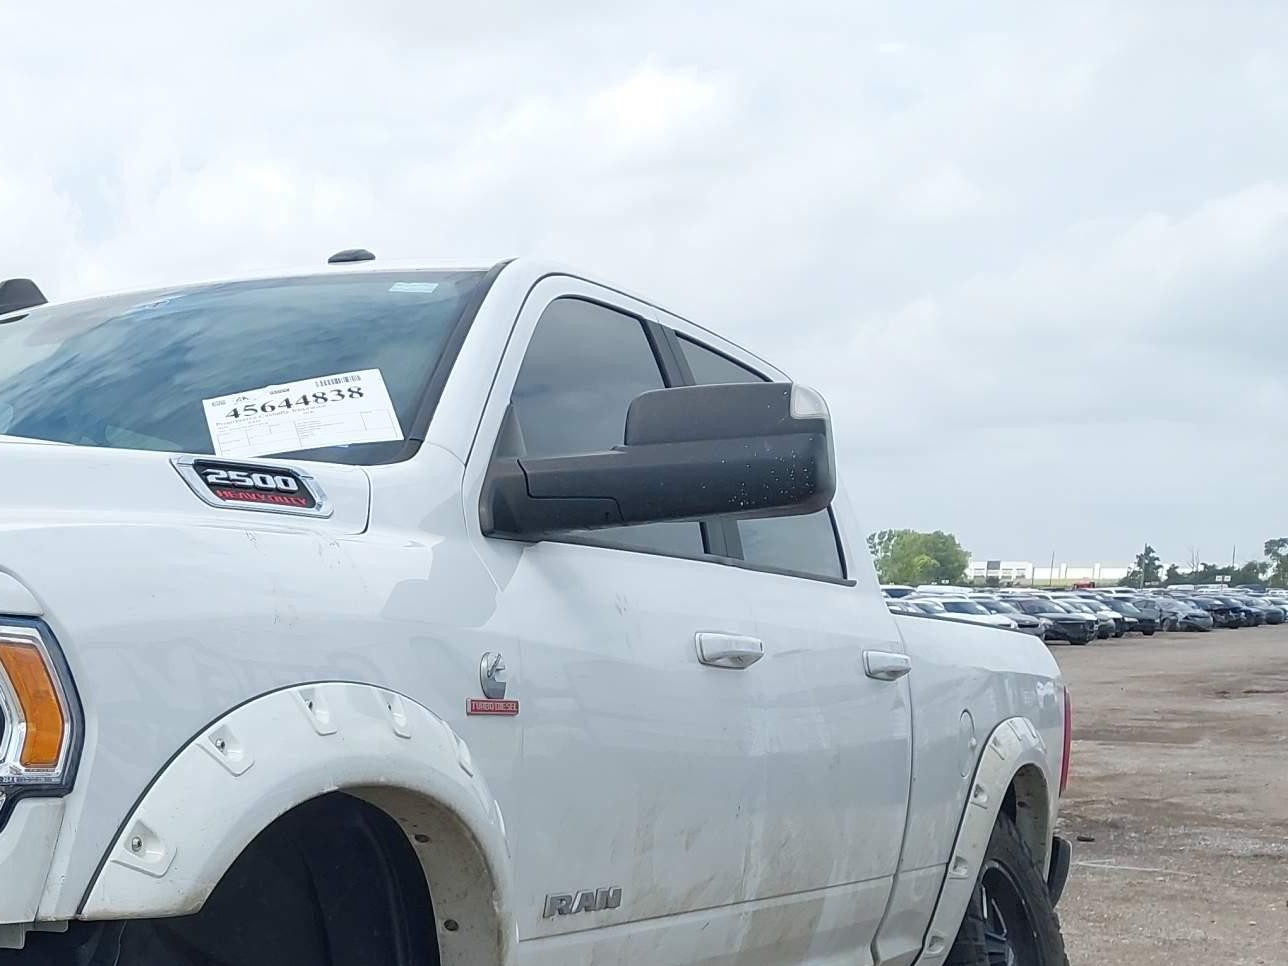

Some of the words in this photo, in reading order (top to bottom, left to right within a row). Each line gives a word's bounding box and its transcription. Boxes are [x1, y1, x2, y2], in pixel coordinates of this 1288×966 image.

[224, 386, 365, 420] 45644838
[202, 468, 300, 492] 2500
[542, 887, 623, 919] RAM
